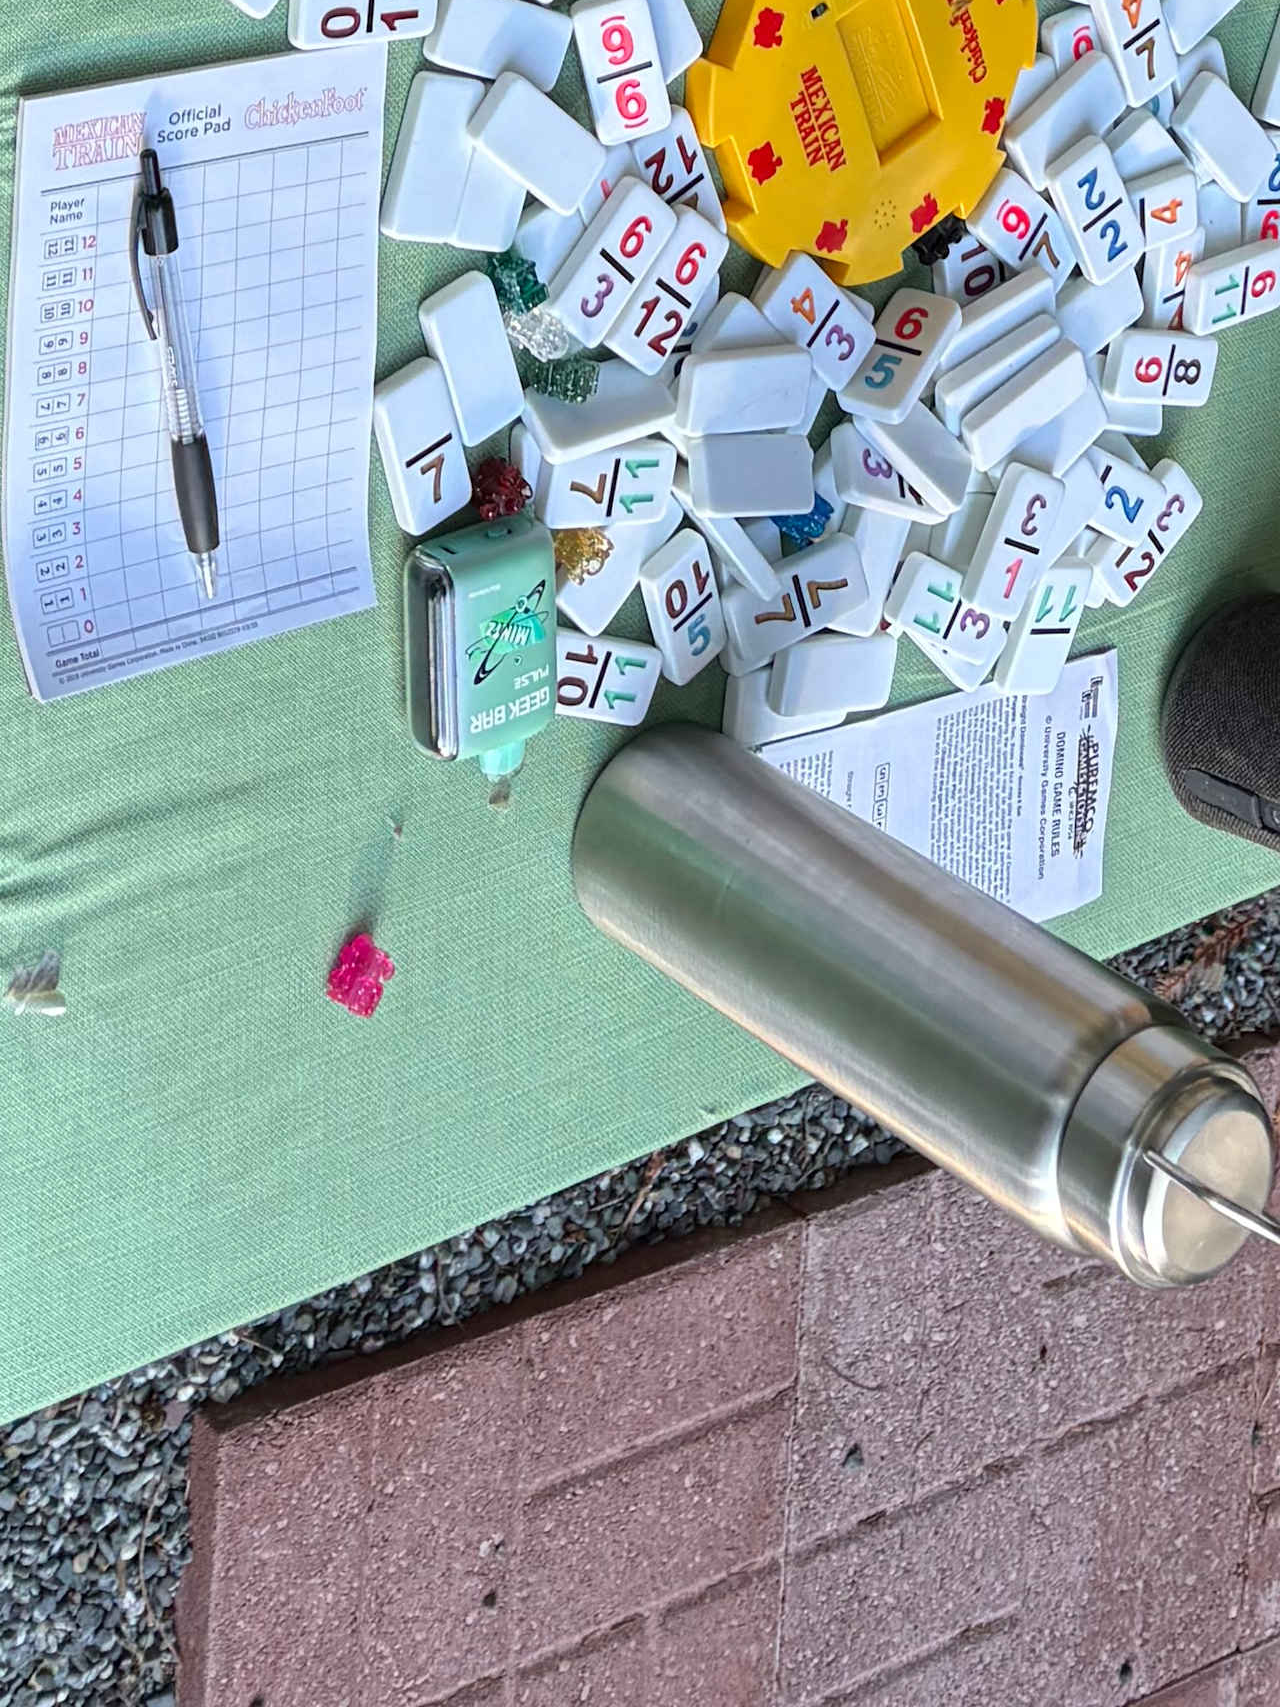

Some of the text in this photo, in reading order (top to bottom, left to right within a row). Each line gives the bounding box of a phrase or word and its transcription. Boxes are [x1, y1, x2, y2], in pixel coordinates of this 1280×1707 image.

[1135, 36, 1156, 80] 7
[52, 112, 147, 148] MEXICAN
[157, 117, 232, 144] Score Pad
[169, 103, 222, 126] Official
[790, 91, 824, 168] TRAIN
[800, 65, 847, 172] MEXICAN
[52, 136, 144, 171] TRAIN
[644, 134, 698, 194] 12
[50, 197, 85, 214] Player
[1077, 167, 1106, 210] 2
[50, 210, 83, 225] Name
[1150, 198, 1183, 223] 4
[82, 235, 96, 249] 12
[1032, 231, 1060, 268] 7
[1099, 219, 1128, 262] 2
[82, 267, 93, 281] 11
[78, 299, 94, 313] 10
[581, 273, 614, 318] 3
[791, 288, 816, 325] 4
[1211, 273, 1240, 324] 11
[79, 331, 89, 345] 9
[634, 295, 683, 357] 12
[825, 324, 856, 361] 3
[77, 362, 87, 375] 8
[864, 353, 903, 389] 5
[1174, 358, 1201, 385] 8
[77, 393, 86, 407] 7
[75, 427, 85, 439] 6
[73, 457, 82, 470] 5
[420, 453, 445, 504] 7
[862, 448, 893, 479] 3
[72, 489, 82, 502] 4
[570, 473, 607, 505] 7
[619, 458, 660, 514] 11
[1021, 493, 1047, 536] 3
[1105, 486, 1144, 523] 2
[1156, 493, 1184, 532] 3
[72, 522, 81, 536] 3
[74, 555, 84, 569] 2
[1004, 557, 1024, 599] 1
[80, 587, 88, 601] 1
[665, 559, 709, 620] 10
[805, 577, 850, 610] 7
[913, 580, 955, 634] 11
[1035, 585, 1077, 623] 11
[84, 619, 94, 633] 0
[754, 592, 795, 627] 7
[960, 608, 991, 640] 3
[687, 614, 711, 656] 5
[55, 649, 100, 668] Game Total
[556, 643, 596, 708] 10
[513, 663, 550, 691] PULSE
[604, 655, 647, 711] 11
[470, 686, 551, 735] GEEK BAR
[1040, 725, 1051, 777] University
[1039, 780, 1050, 816] Games
[1049, 731, 1066, 858] DOMINO GAME RULES
[1036, 819, 1048, 880] Corporation
